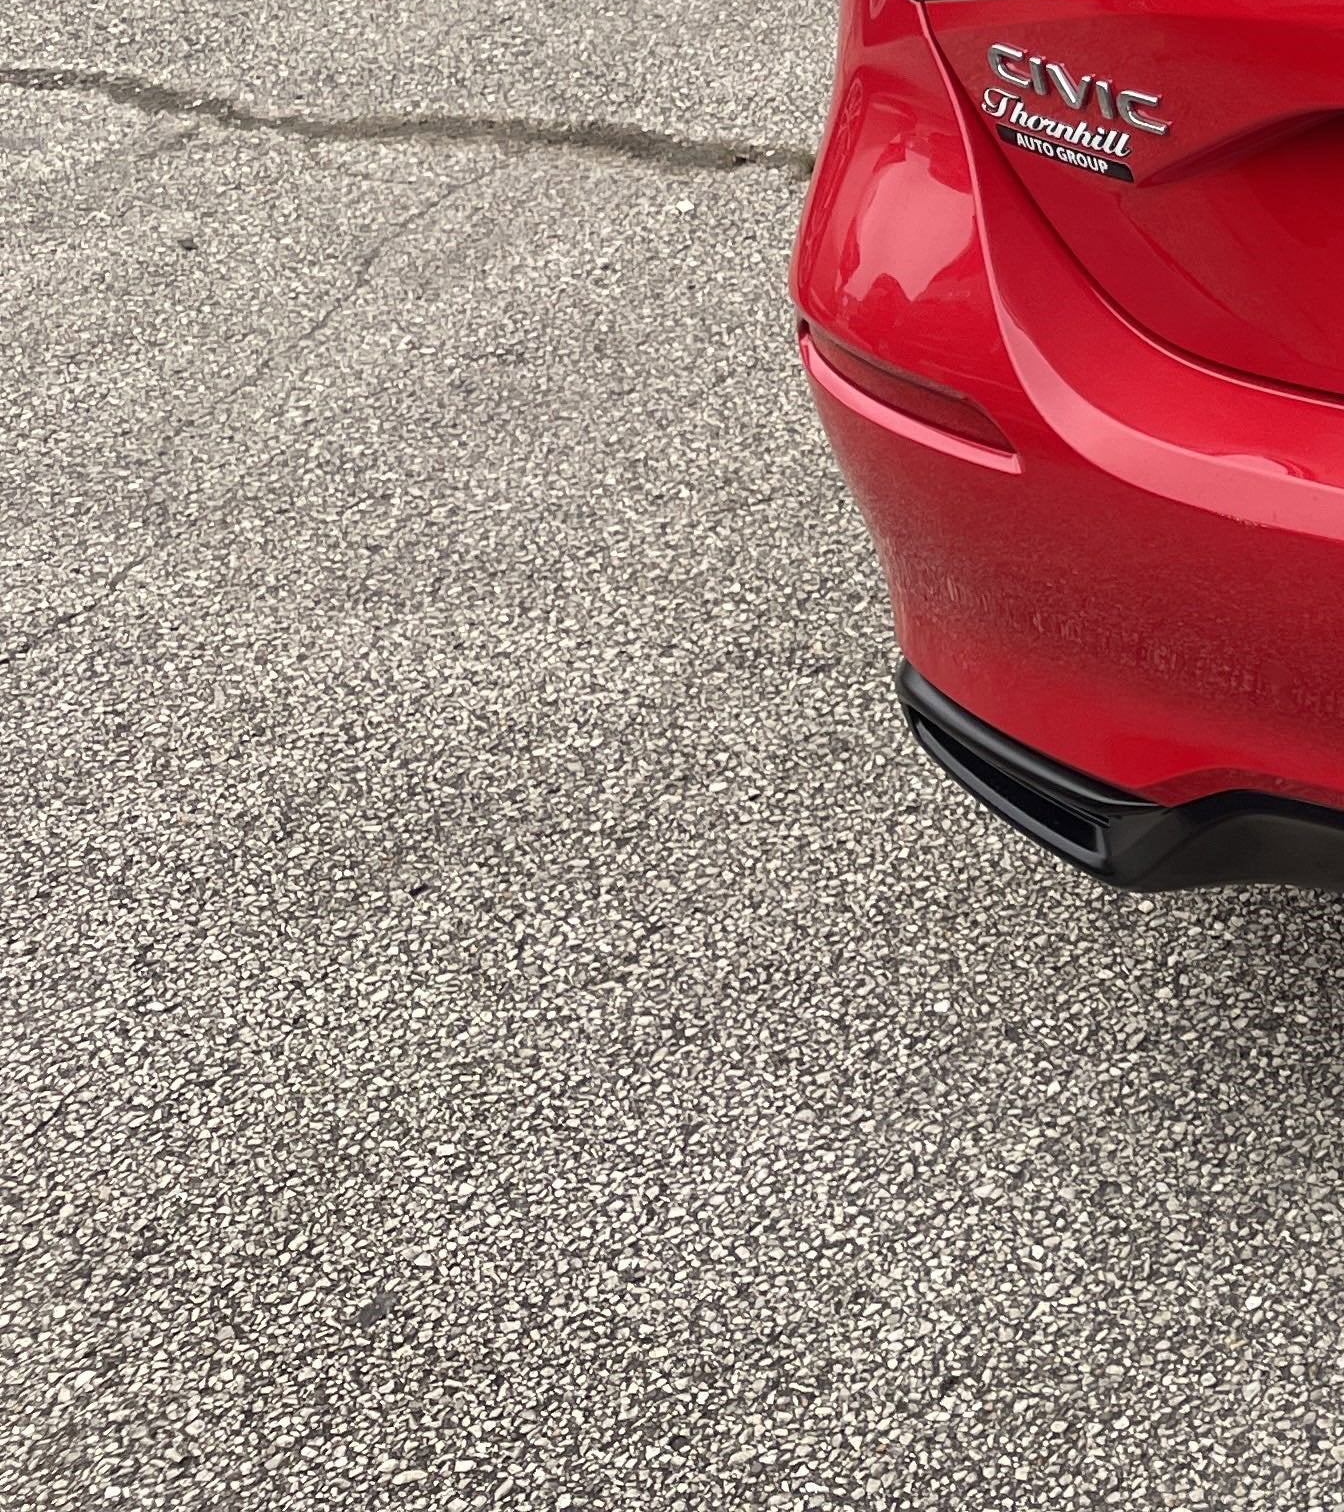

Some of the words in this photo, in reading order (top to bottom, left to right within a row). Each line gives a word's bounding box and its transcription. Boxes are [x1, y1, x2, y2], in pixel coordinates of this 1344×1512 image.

[981, 87, 1131, 158] Thornhill
[987, 43, 1168, 136] CIVIC
[1016, 133, 1055, 157] AUTO
[1057, 148, 1109, 174] GROUP
